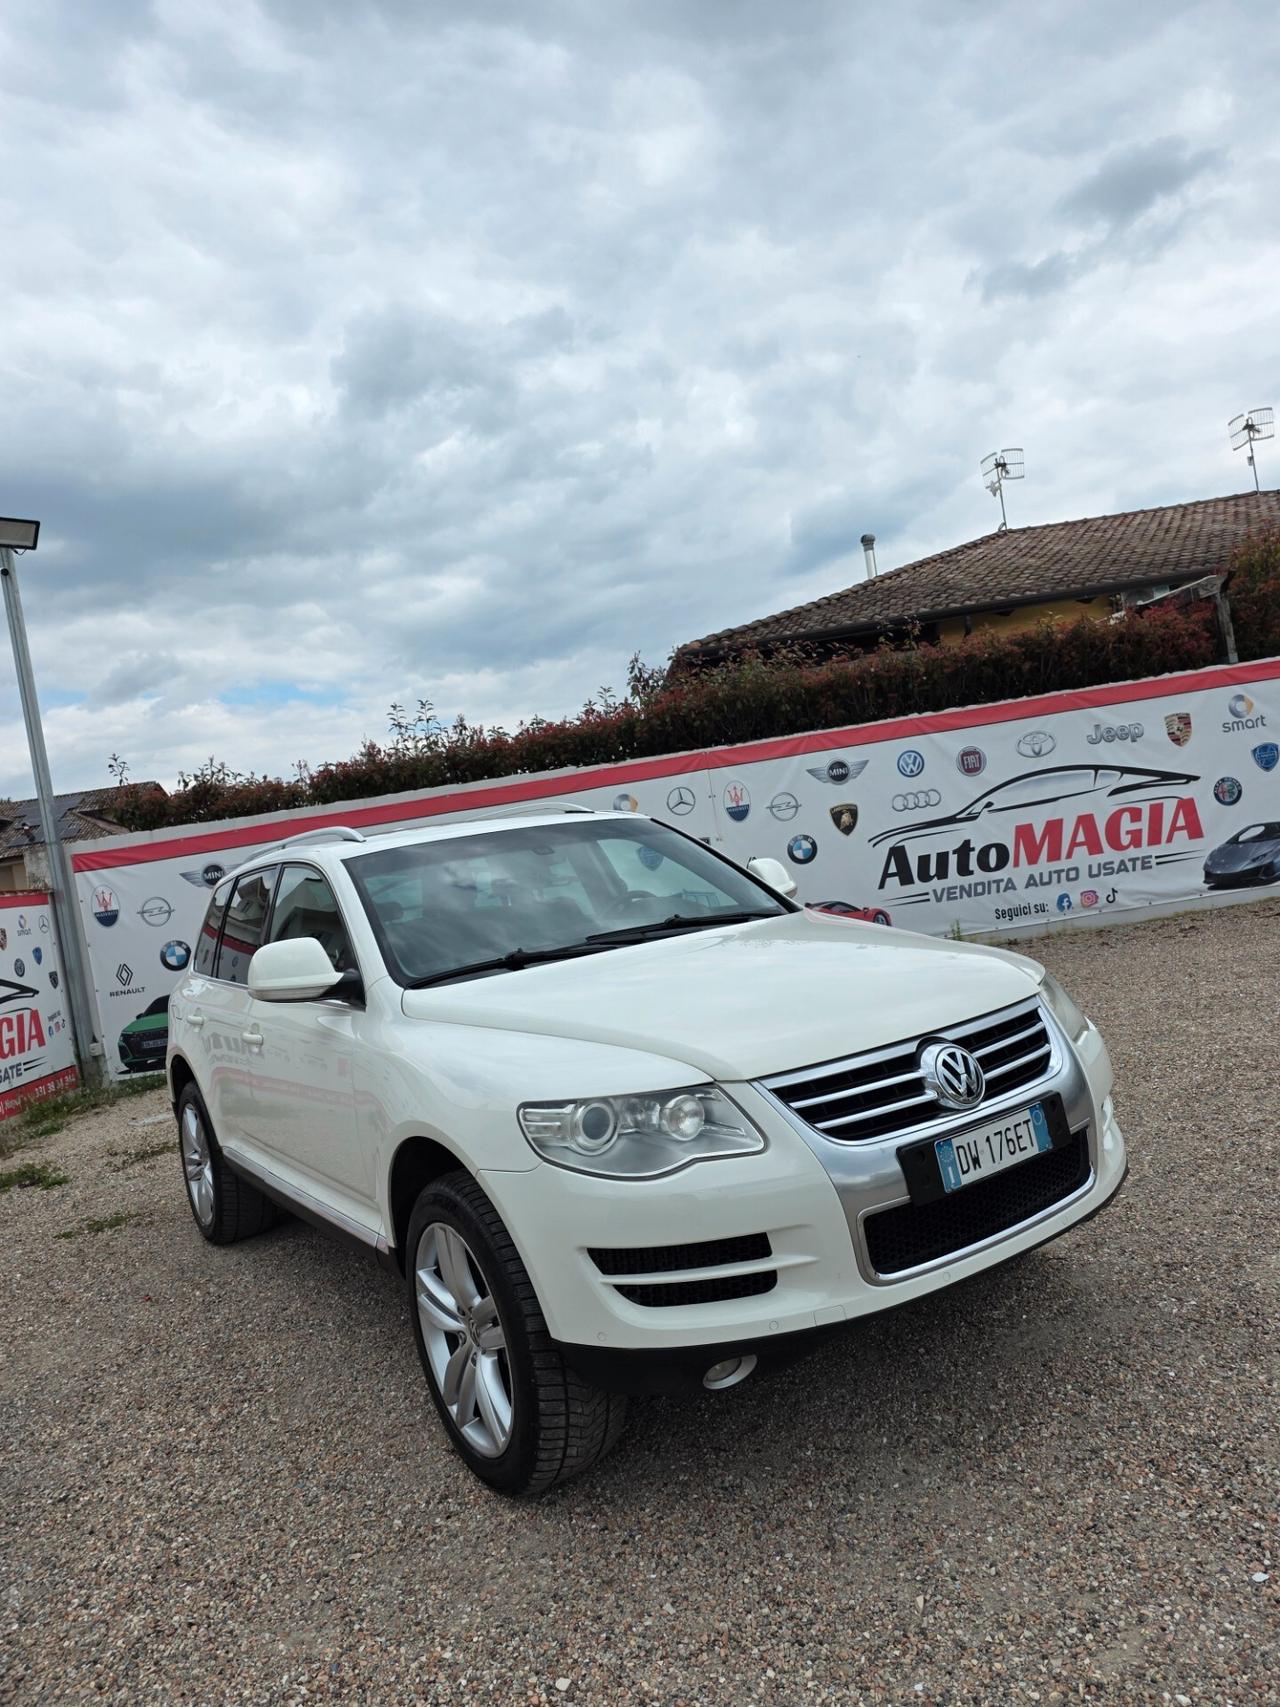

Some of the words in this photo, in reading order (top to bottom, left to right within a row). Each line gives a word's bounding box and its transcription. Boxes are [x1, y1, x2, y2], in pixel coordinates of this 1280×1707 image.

[1087, 721, 1145, 745] Jeep
[1222, 715, 1267, 733] smart
[962, 754, 981, 770] FIAT
[828, 767, 849, 777] MINI
[932, 877, 1017, 903] VENDITA
[1025, 865, 1080, 889] AUTO
[1087, 855, 1153, 879] USATE
[994, 902, 1032, 921] Seguici
[1033, 902, 1049, 914] su:
[109, 986, 146, 998] RENAULT
[955, 1139, 982, 1176] DW
[985, 1118, 1035, 1164] 176ET
